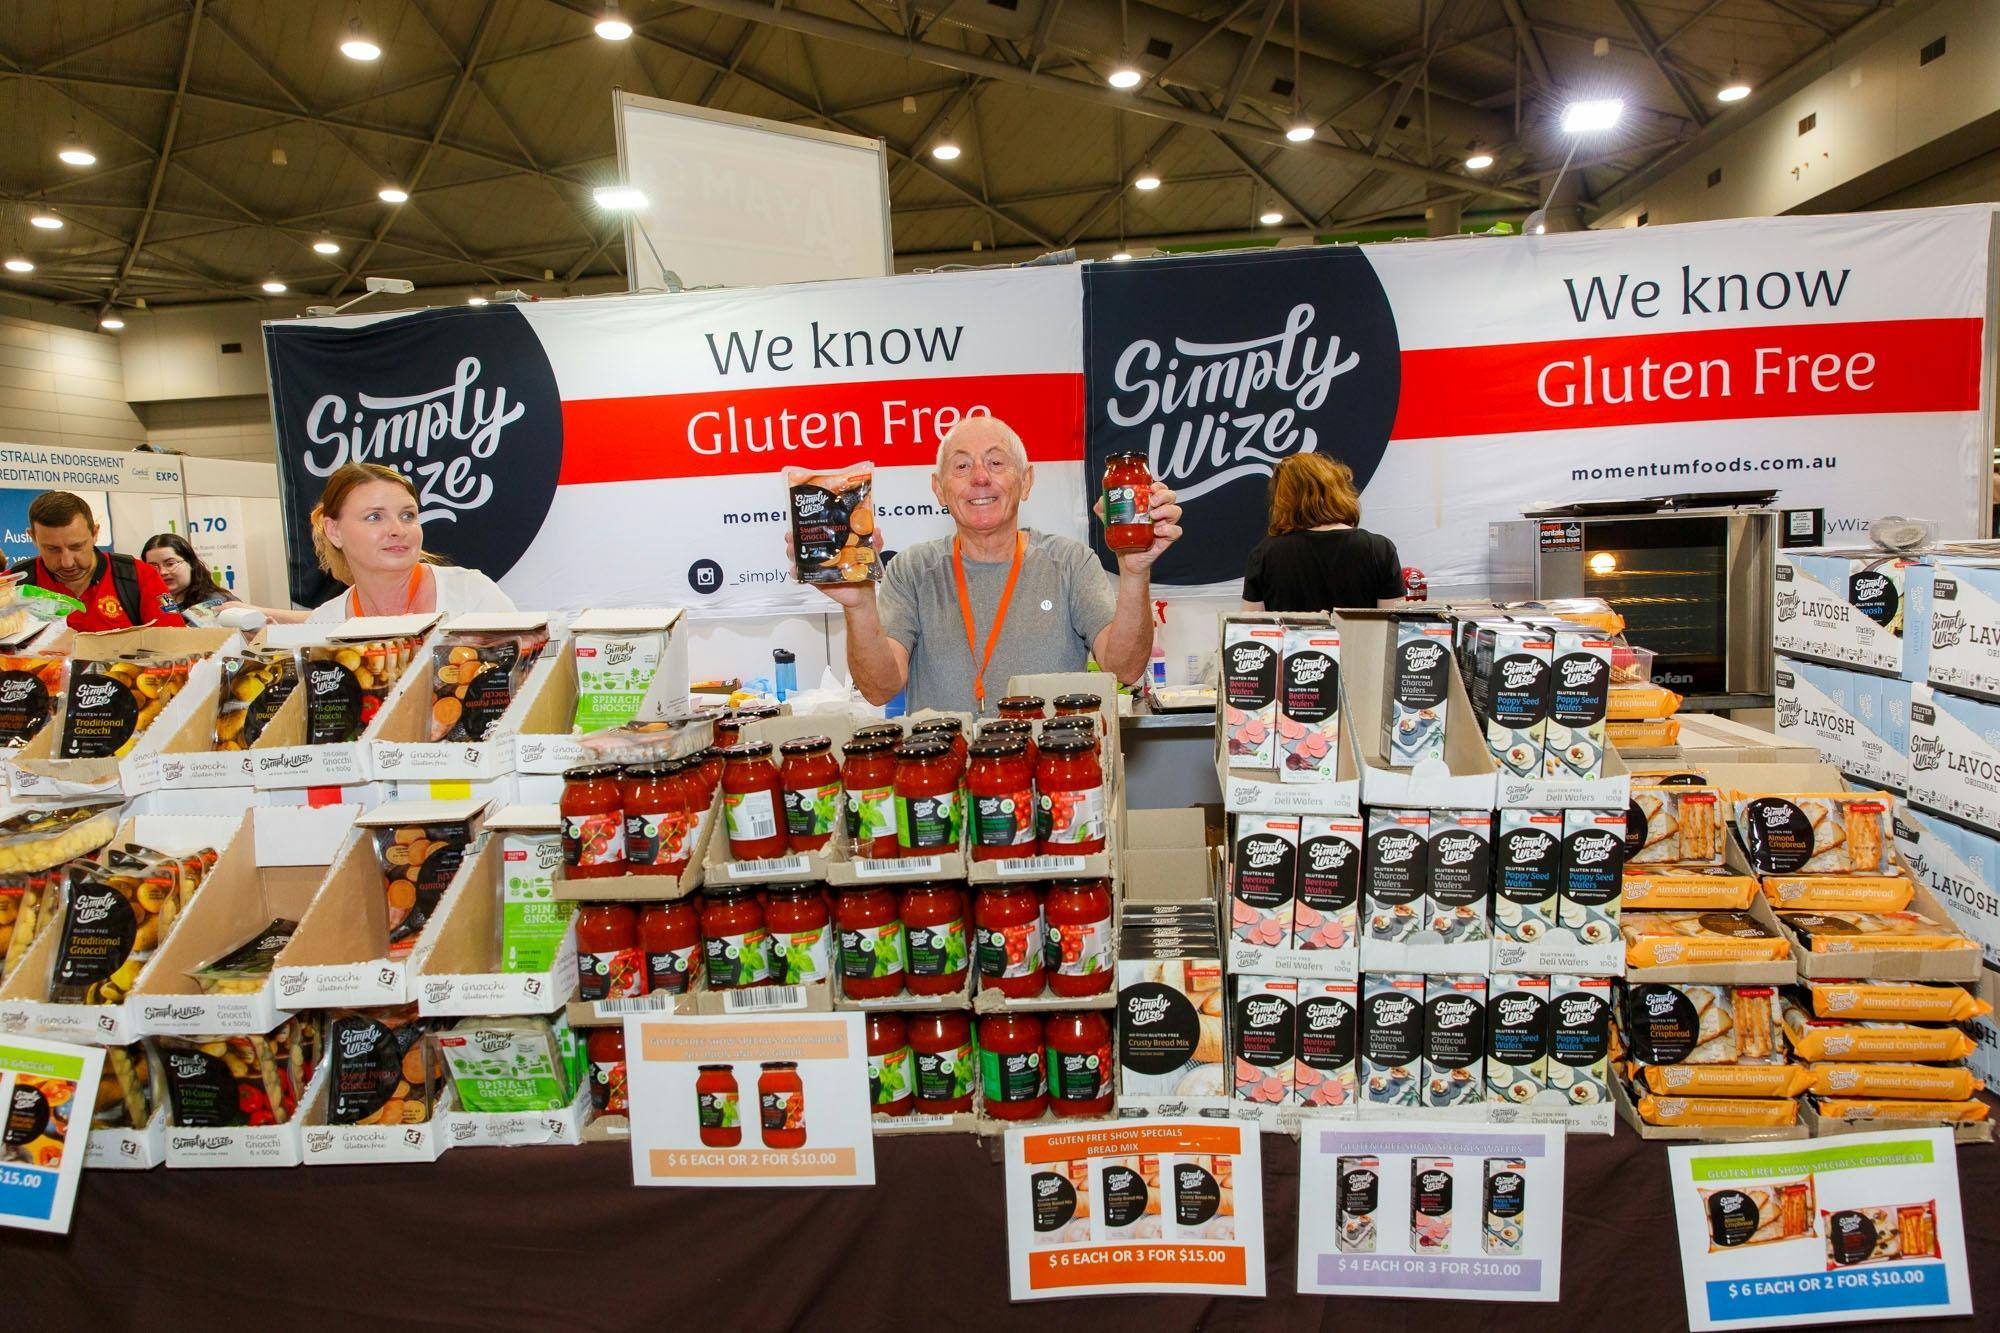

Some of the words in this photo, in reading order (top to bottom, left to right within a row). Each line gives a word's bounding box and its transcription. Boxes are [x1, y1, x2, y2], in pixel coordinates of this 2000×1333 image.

[1563, 274, 1661, 323] We
[1680, 265, 1851, 315] know
[705, 330, 793, 375] We
[811, 321, 964, 368] know
[1107, 303, 1360, 430] Simply
[1537, 355, 1730, 409] Gluten
[1754, 346, 1876, 396] Free
[303, 356, 525, 477] Simply
[687, 405, 863, 455] Gluten
[51, 454, 124, 469] ENDORSEMENT
[1147, 409, 1317, 500] Wize
[156, 472, 179, 482] EXPO
[1571, 456, 1837, 484] momentumfoods.com.au
[63, 473, 120, 485] PROGRAMS
[388, 455, 493, 525] ize
[795, 491, 829, 506] Simply
[799, 504, 824, 517] Wize
[203, 517, 227, 532] 70
[1855, 575, 1888, 590] Simply
[1776, 590, 1800, 609] Simply
[1858, 588, 1882, 601] Wize
[1778, 607, 1796, 622] Wize
[1802, 601, 1849, 622] LAVOSH
[1860, 606, 1882, 615] avosh
[1932, 610, 1967, 633] Simply
[1932, 631, 1960, 649] Wize
[605, 642, 637, 655] Simply
[1405, 644, 1443, 662] Simply
[607, 653, 631, 665] Wize
[1291, 655, 1331, 675] Simply
[1408, 658, 1437, 672] Wize
[1561, 657, 1603, 677] Simply
[1294, 669, 1325, 685] Wize
[1401, 679, 1433, 687] Charcoal
[1564, 671, 1595, 688] Wize
[1652, 673, 1693, 684] ofan
[76, 682, 118, 700] Simply
[1288, 692, 1320, 700] Beetroot
[1401, 686, 1426, 695] Wafers
[79, 695, 110, 708] Wize
[592, 695, 640, 704] SPINACH
[1288, 699, 1314, 708] Wafers
[1557, 696, 1578, 705] Poppy
[1581, 696, 1599, 704] Seed
[1777, 697, 1802, 716] Simply
[592, 704, 640, 713] GNOCCHI
[1556, 703, 1582, 712] Wafers
[75, 719, 123, 727] Traditional
[1804, 709, 1855, 736] LAVOSH
[74, 727, 111, 735] Gnocchi
[1911, 735, 1945, 758] Simply
[1913, 753, 1939, 771] Wize
[1964, 777, 1998, 793] ORIGINAL
[1762, 804, 1793, 817] Simply
[1766, 816, 1789, 827] Wize
[1931, 872, 2000, 917] LAVOSH
[1948, 899, 1981, 919] ORIGINAL
[280, 972, 310, 986] Simply
[316, 972, 362, 983] Gnocchi
[1128, 993, 1170, 1016] Simply
[1132, 1010, 1164, 1025] Wize
[1128, 1039, 1152, 1048] Crusty
[1154, 1039, 1174, 1047] Bread
[1177, 1039, 1189, 1047] Mix
[1048, 1133, 1084, 1146] GLUTEN
[1087, 1132, 1108, 1143] FREE
[1110, 1130, 1139, 1141] SHOW
[1141, 1128, 1183, 1139] SPECIALS
[1088, 1144, 1118, 1154] BREAD
[1120, 1143, 1139, 1152] MIX
[668, 1153, 676, 1166] $
[680, 1154, 687, 1166] 6
[691, 1154, 725, 1166] EACH
[728, 1154, 747, 1166] OR
[751, 1154, 759, 1165] 2
[762, 1153, 788, 1165] FOR
[792, 1152, 836, 1165] $10.00
[1707, 1168, 1749, 1179] GLUTEN
[1751, 1167, 1774, 1177] FREE
[1777, 1165, 1809, 1175] SHOW
[1812, 1160, 1856, 1173] SPECIALS
[1859, 1153, 1923, 1166] CRISPBREAD
[1049, 1254, 1058, 1268] $
[1061, 1254, 1069, 1266] 6
[1073, 1252, 1109, 1265] EACH
[1112, 1251, 1133, 1263] OR
[1136, 1250, 1144, 1262] 3
[1148, 1249, 1176, 1261] FOR
[1179, 1249, 1226, 1263] $15.00
[1338, 1258, 1346, 1273] $
[1350, 1258, 1359, 1271] 4
[1363, 1259, 1400, 1272] EACH
[1404, 1260, 1424, 1273] OR
[1429, 1261, 1437, 1273] 3
[1441, 1261, 1469, 1274] FOR
[1473, 1262, 1521, 1276] $10.00
[1728, 1283, 1737, 1299] $
[1742, 1283, 1751, 1296] 6
[1755, 1280, 1795, 1296] EACH
[1799, 1278, 1821, 1291] OR
[1825, 1276, 1834, 1290] 2
[1838, 1274, 1868, 1288] FOR
[1872, 1269, 1924, 1286] $10.00
